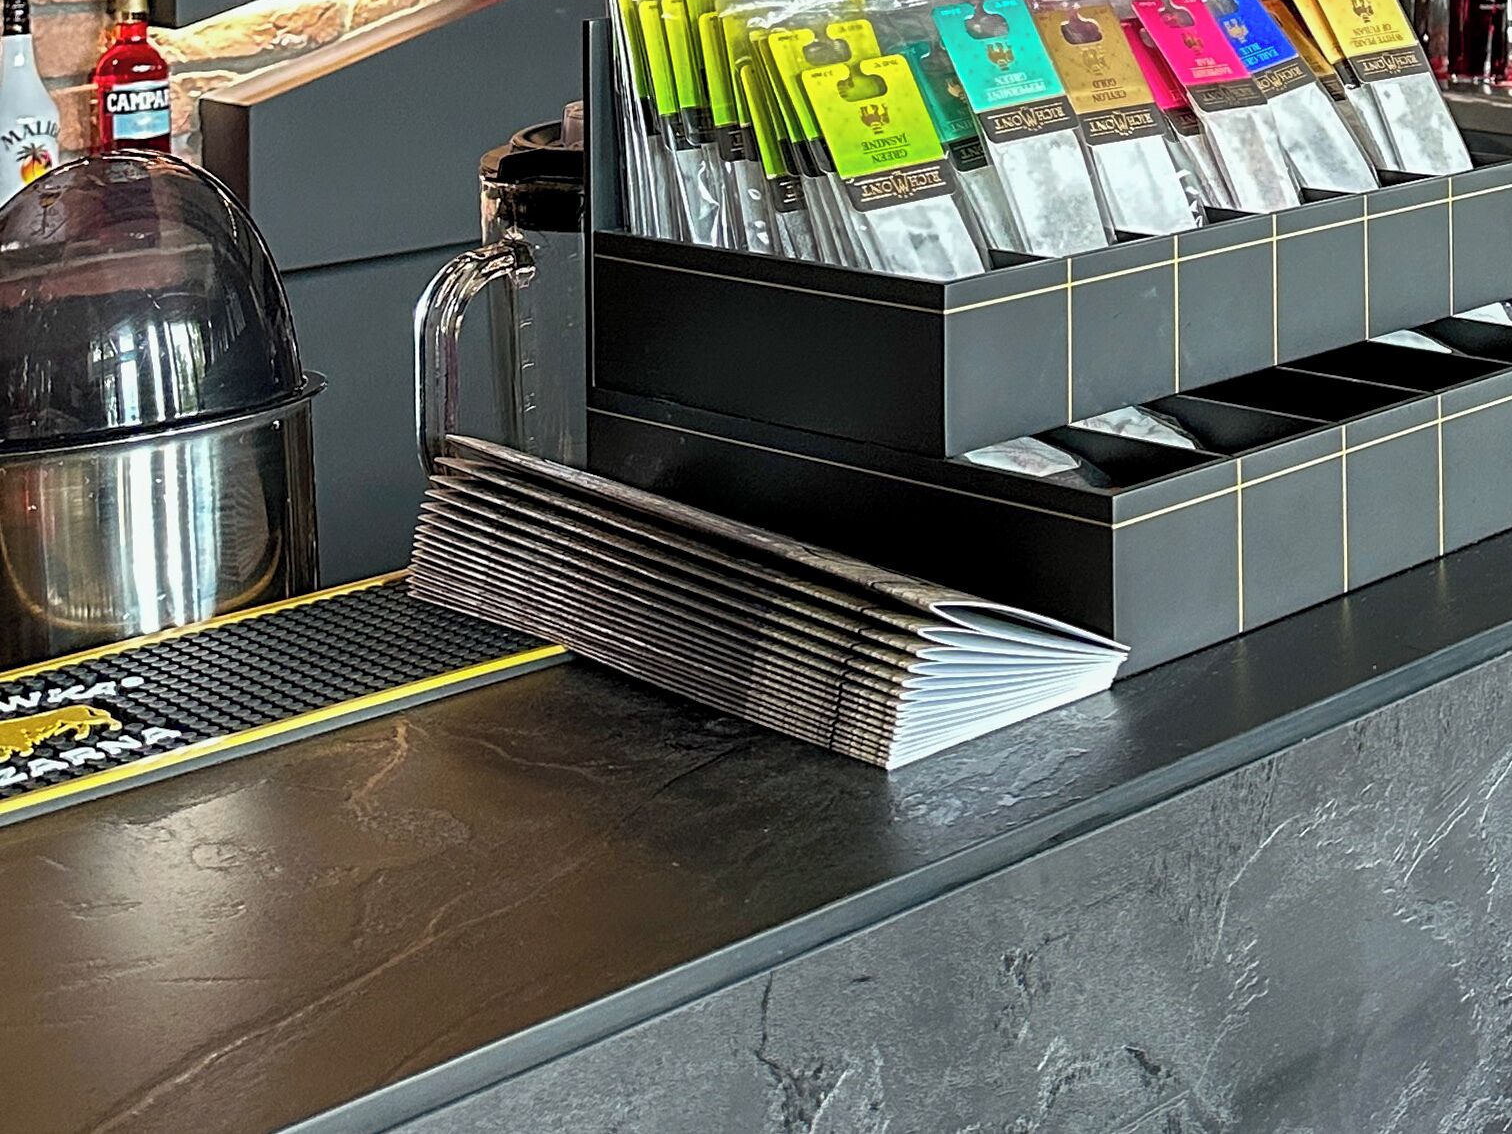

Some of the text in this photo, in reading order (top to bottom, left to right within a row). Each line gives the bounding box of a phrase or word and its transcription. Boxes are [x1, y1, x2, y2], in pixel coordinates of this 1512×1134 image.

[1378, 33, 1404, 45] WHITE
[1362, 53, 1419, 73] RICHMONT
[994, 105, 1066, 131] RICHMONT
[1089, 111, 1154, 134] RICHMONT
[1, 120, 59, 152] MALIB
[861, 132, 908, 151] JASMINE
[872, 149, 908, 164] GREEN
[861, 170, 943, 198] RICHMONT
